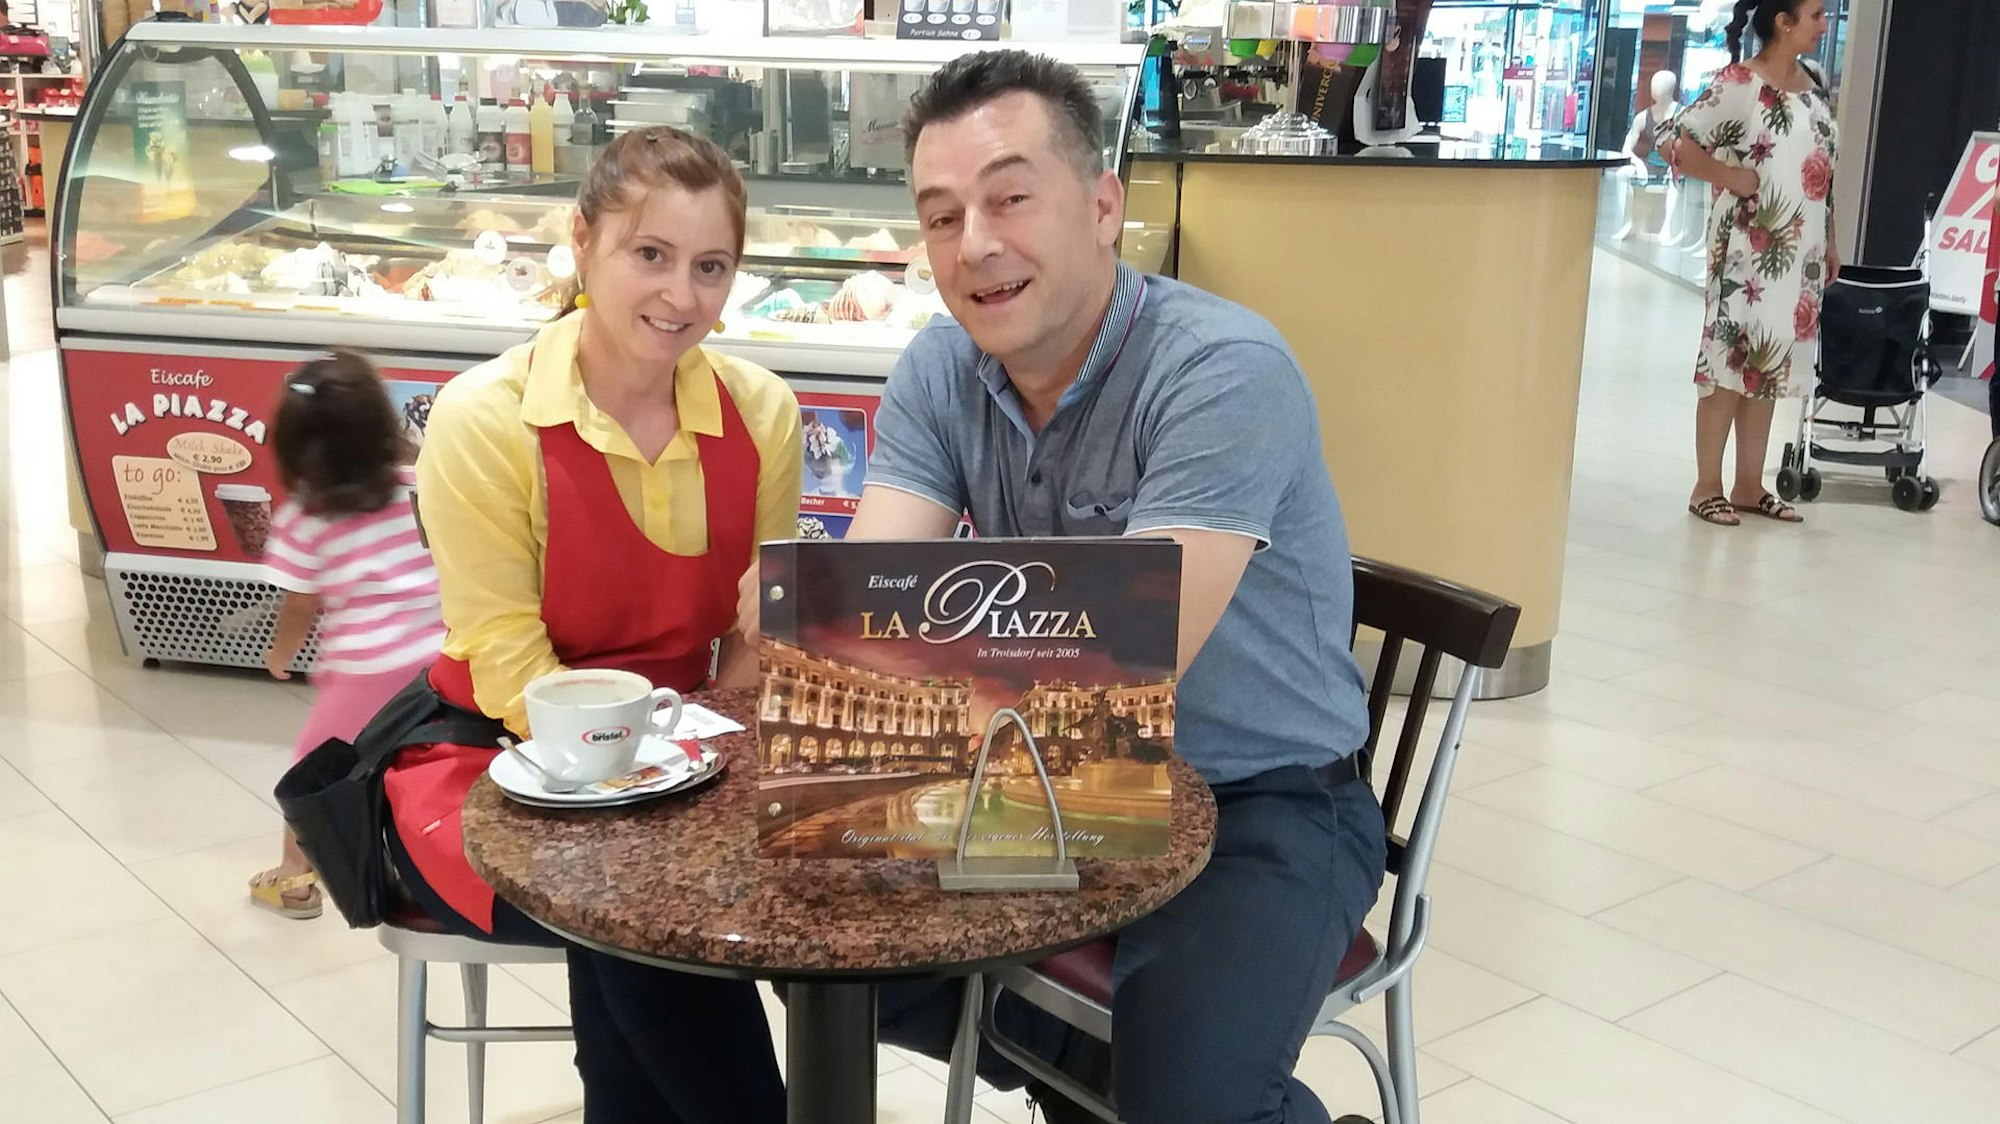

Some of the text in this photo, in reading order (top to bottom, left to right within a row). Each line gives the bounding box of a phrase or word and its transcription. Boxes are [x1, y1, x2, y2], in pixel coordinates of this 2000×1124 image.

[1938, 226, 1988, 255] SAL
[150, 368, 214, 389] Eiscafe
[110, 392, 266, 445] LA PIAZZA
[123, 463, 182, 495] to go:
[868, 574, 918, 592] Eiscafé
[860, 560, 1097, 644] LA PIAZZA
[977, 648, 1080, 660] In Troisdorf seit 2005
[1025, 825, 1105, 848] Hertellung
